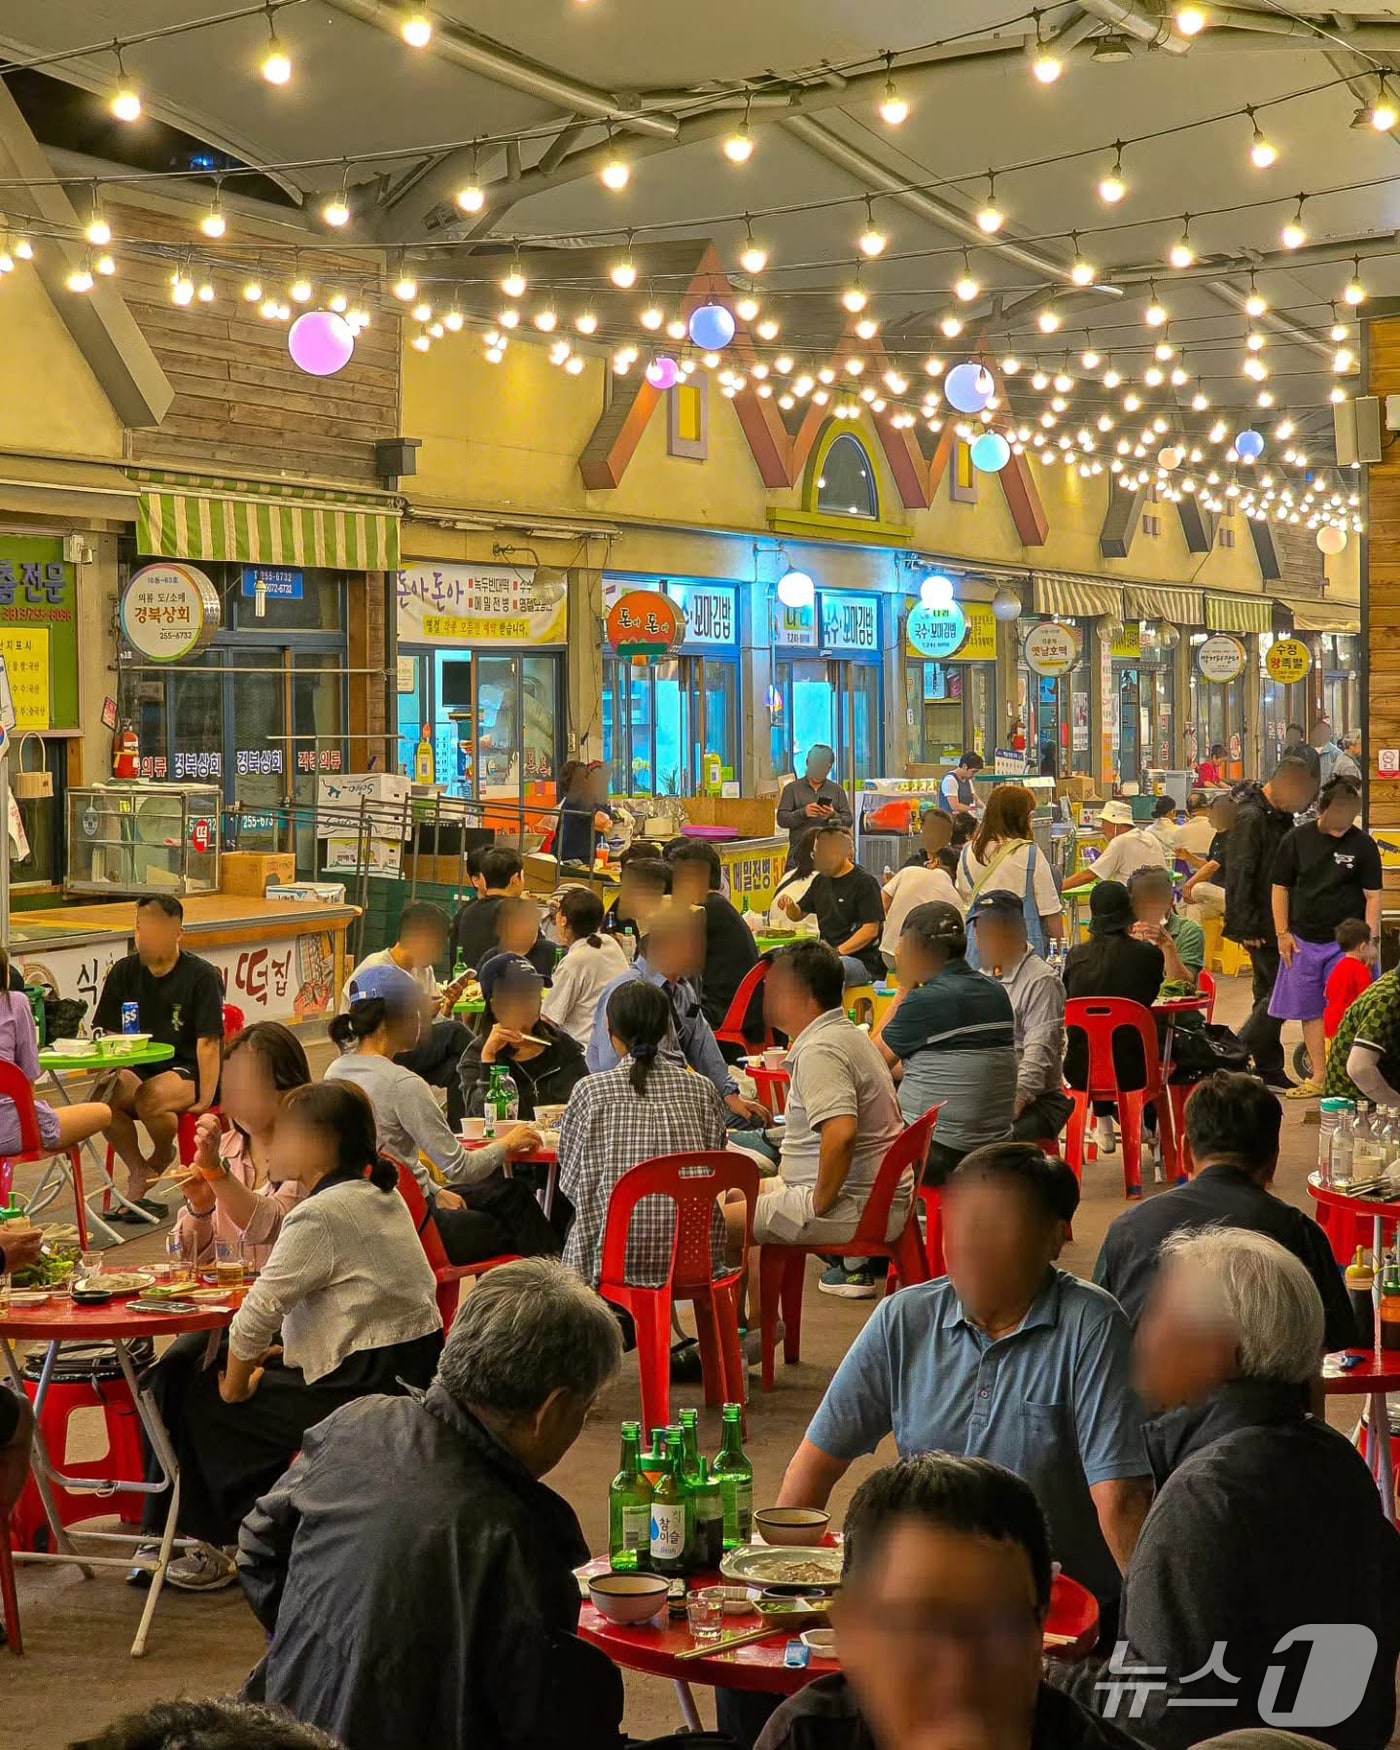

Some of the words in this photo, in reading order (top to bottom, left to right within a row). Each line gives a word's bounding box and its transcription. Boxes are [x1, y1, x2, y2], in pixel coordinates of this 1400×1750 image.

[138, 593, 154, 603] 의류
[135, 606, 190, 623] 경북상회
[160, 632, 192, 640] 255-6732
[1277, 644, 1297, 656] 수정
[175, 752, 222, 778] 경북상회
[237, 750, 282, 775] 경북상회
